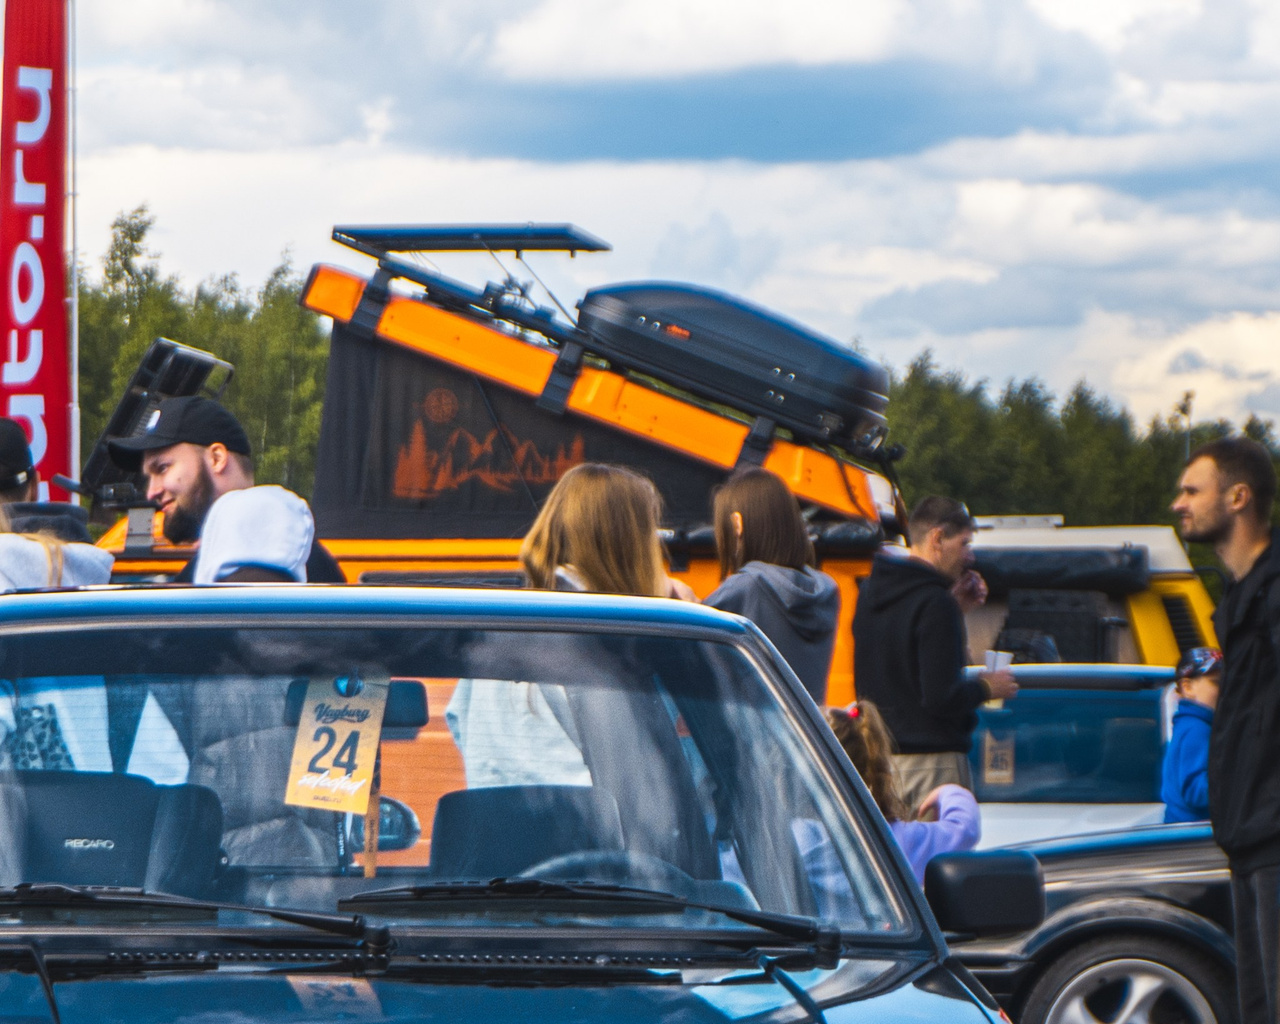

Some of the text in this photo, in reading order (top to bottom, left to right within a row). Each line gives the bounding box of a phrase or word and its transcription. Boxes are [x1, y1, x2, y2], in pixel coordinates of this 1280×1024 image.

[2, 65, 53, 503] uto.ru
[314, 703, 371, 724] Vagburg
[308, 726, 360, 778] 24
[297, 770, 367, 796] selected
[64, 838, 115, 850] RECARO
